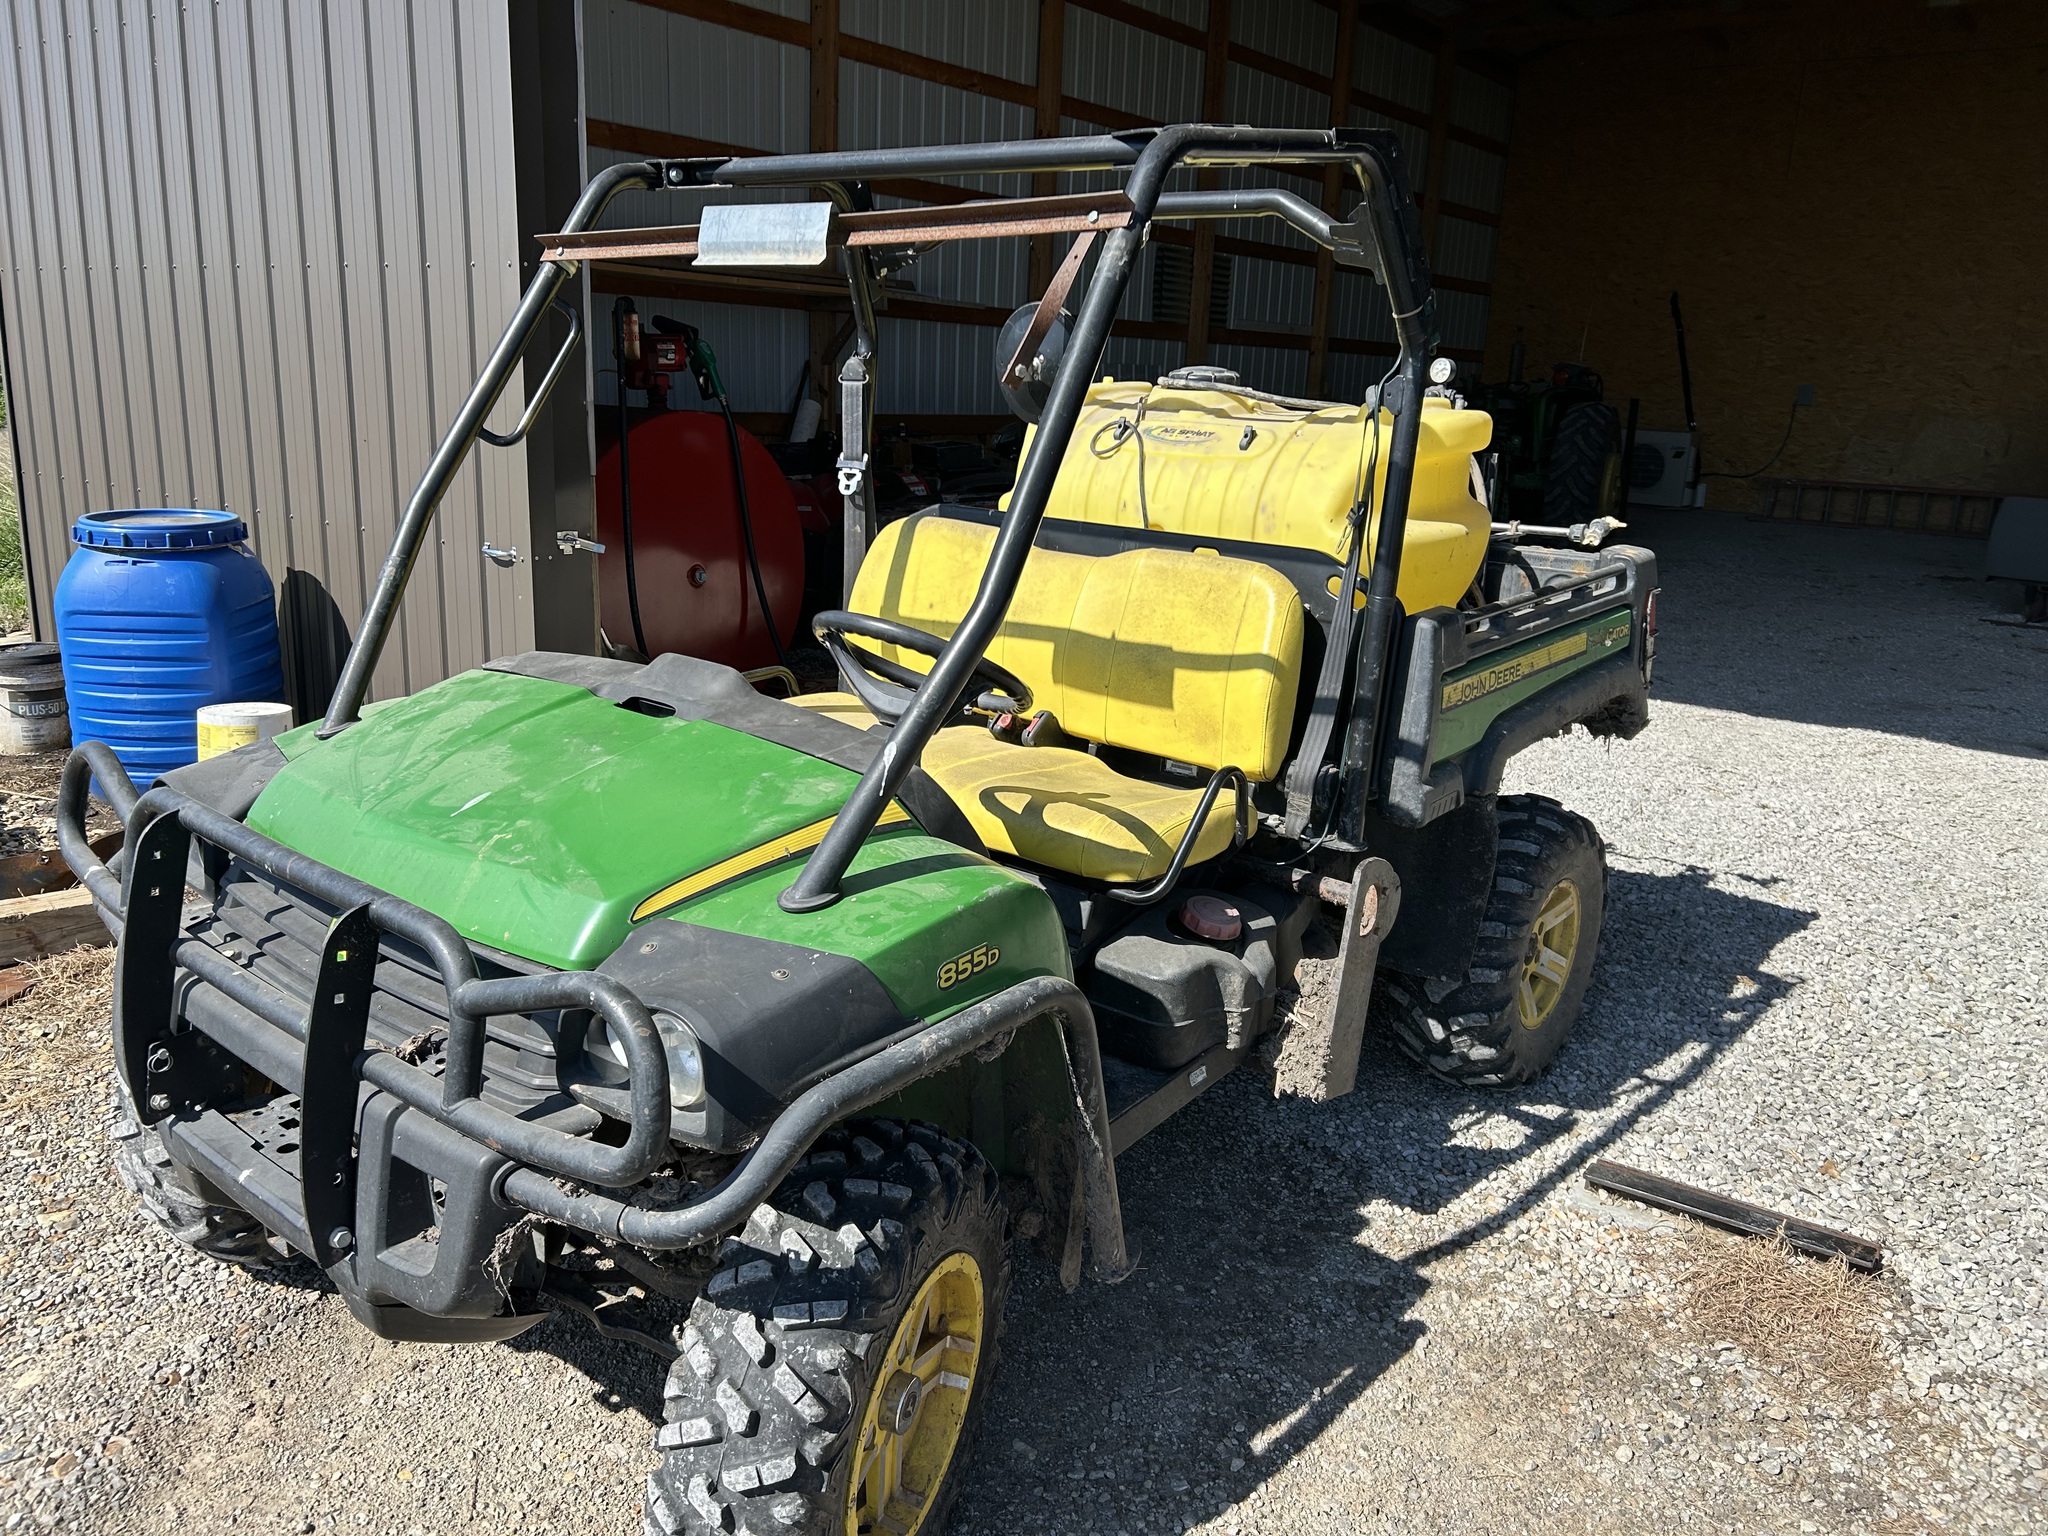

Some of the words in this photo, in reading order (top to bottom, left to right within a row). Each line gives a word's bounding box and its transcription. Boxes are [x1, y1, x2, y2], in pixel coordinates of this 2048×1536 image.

[1457, 675, 1487, 703] JOHN
[1488, 662, 1522, 690] DEERE
[18, 702, 60, 716] PLUS-50
[938, 945, 1000, 989] 855D
